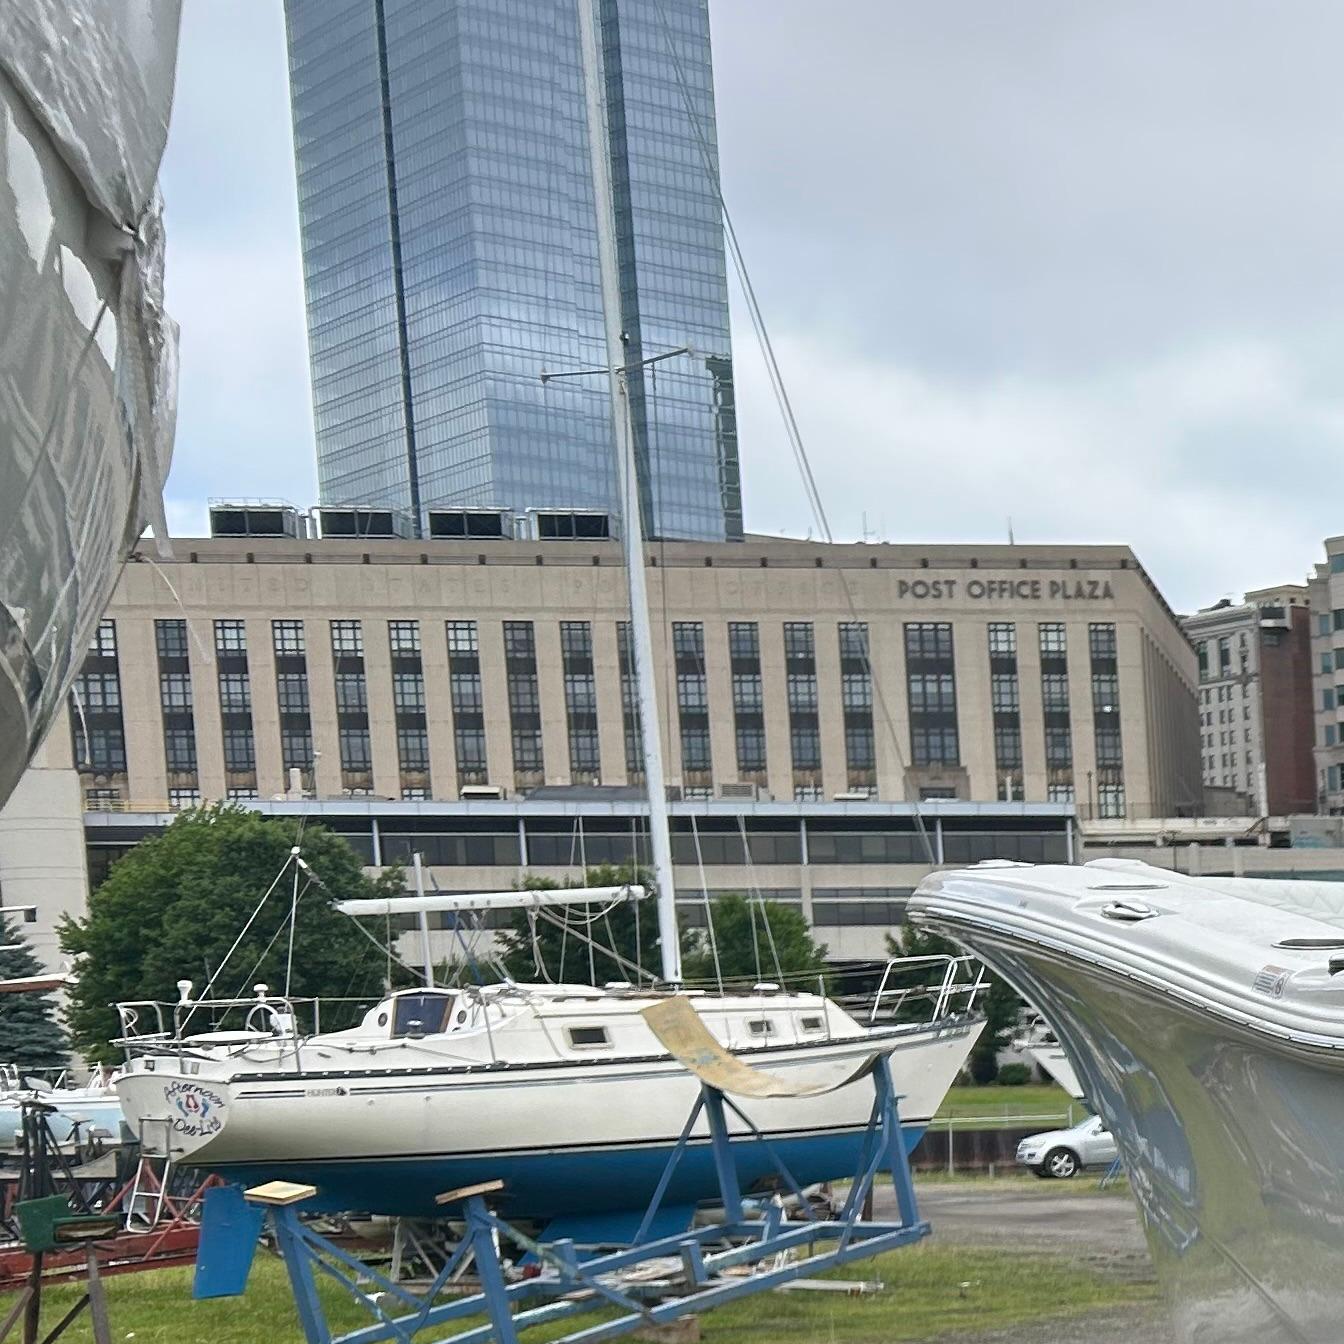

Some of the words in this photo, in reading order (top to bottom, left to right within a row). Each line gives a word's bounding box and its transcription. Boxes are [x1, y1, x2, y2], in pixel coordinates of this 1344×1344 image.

[898, 579, 957, 599] POST
[966, 579, 1041, 599] OFFICE
[1048, 580, 1115, 599] PLAZA
